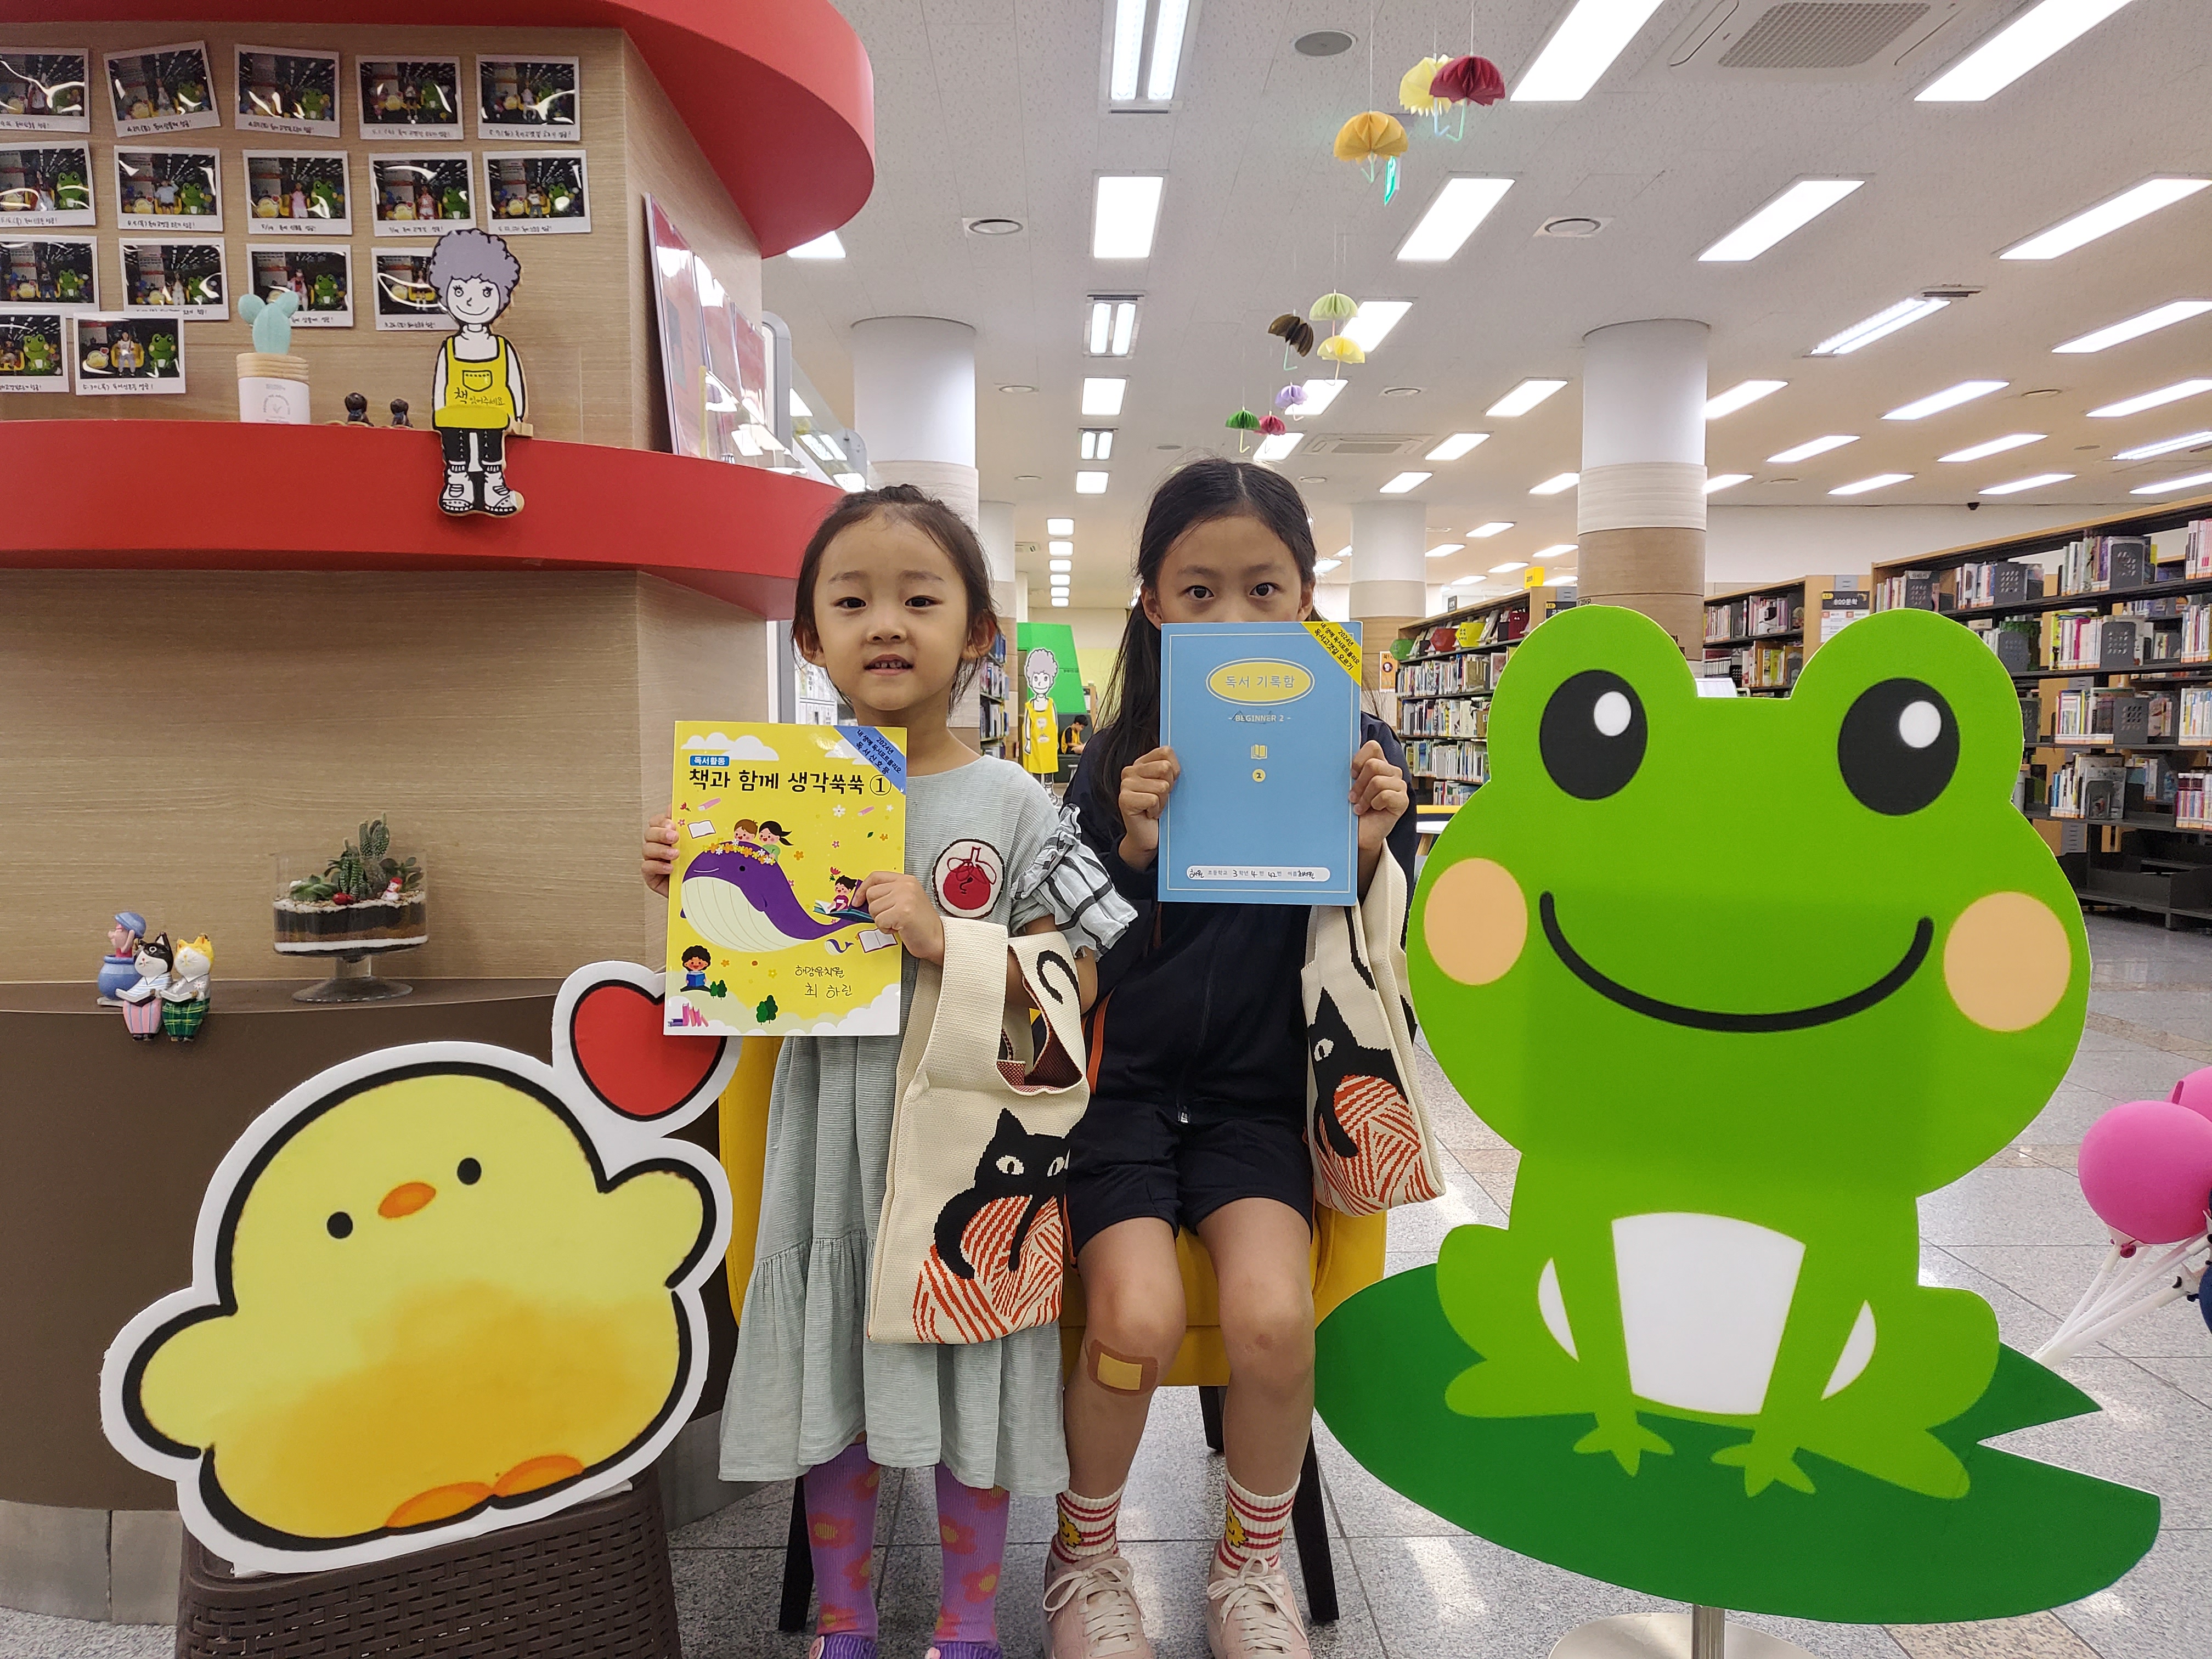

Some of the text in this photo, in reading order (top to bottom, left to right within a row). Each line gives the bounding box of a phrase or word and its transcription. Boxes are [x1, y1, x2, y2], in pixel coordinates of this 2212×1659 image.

[454, 387, 468, 404] 책
[1338, 629, 1354, 647] 2024년
[1314, 628, 1354, 671] 독서고갯길 오르기
[1225, 675, 1295, 689] 독서 기록함
[857, 729, 864, 737] 내
[872, 744, 901, 774] 독서포트폴리오
[876, 737, 895, 755] 2024년
[693, 757, 726, 765] 독서활동
[689, 768, 731, 791] 책과
[738, 769, 779, 791] 함께
[787, 771, 865, 795] 생각쑥쑥
[795, 964, 845, 979] 해강유치원
[804, 982, 853, 998] 최 하린
